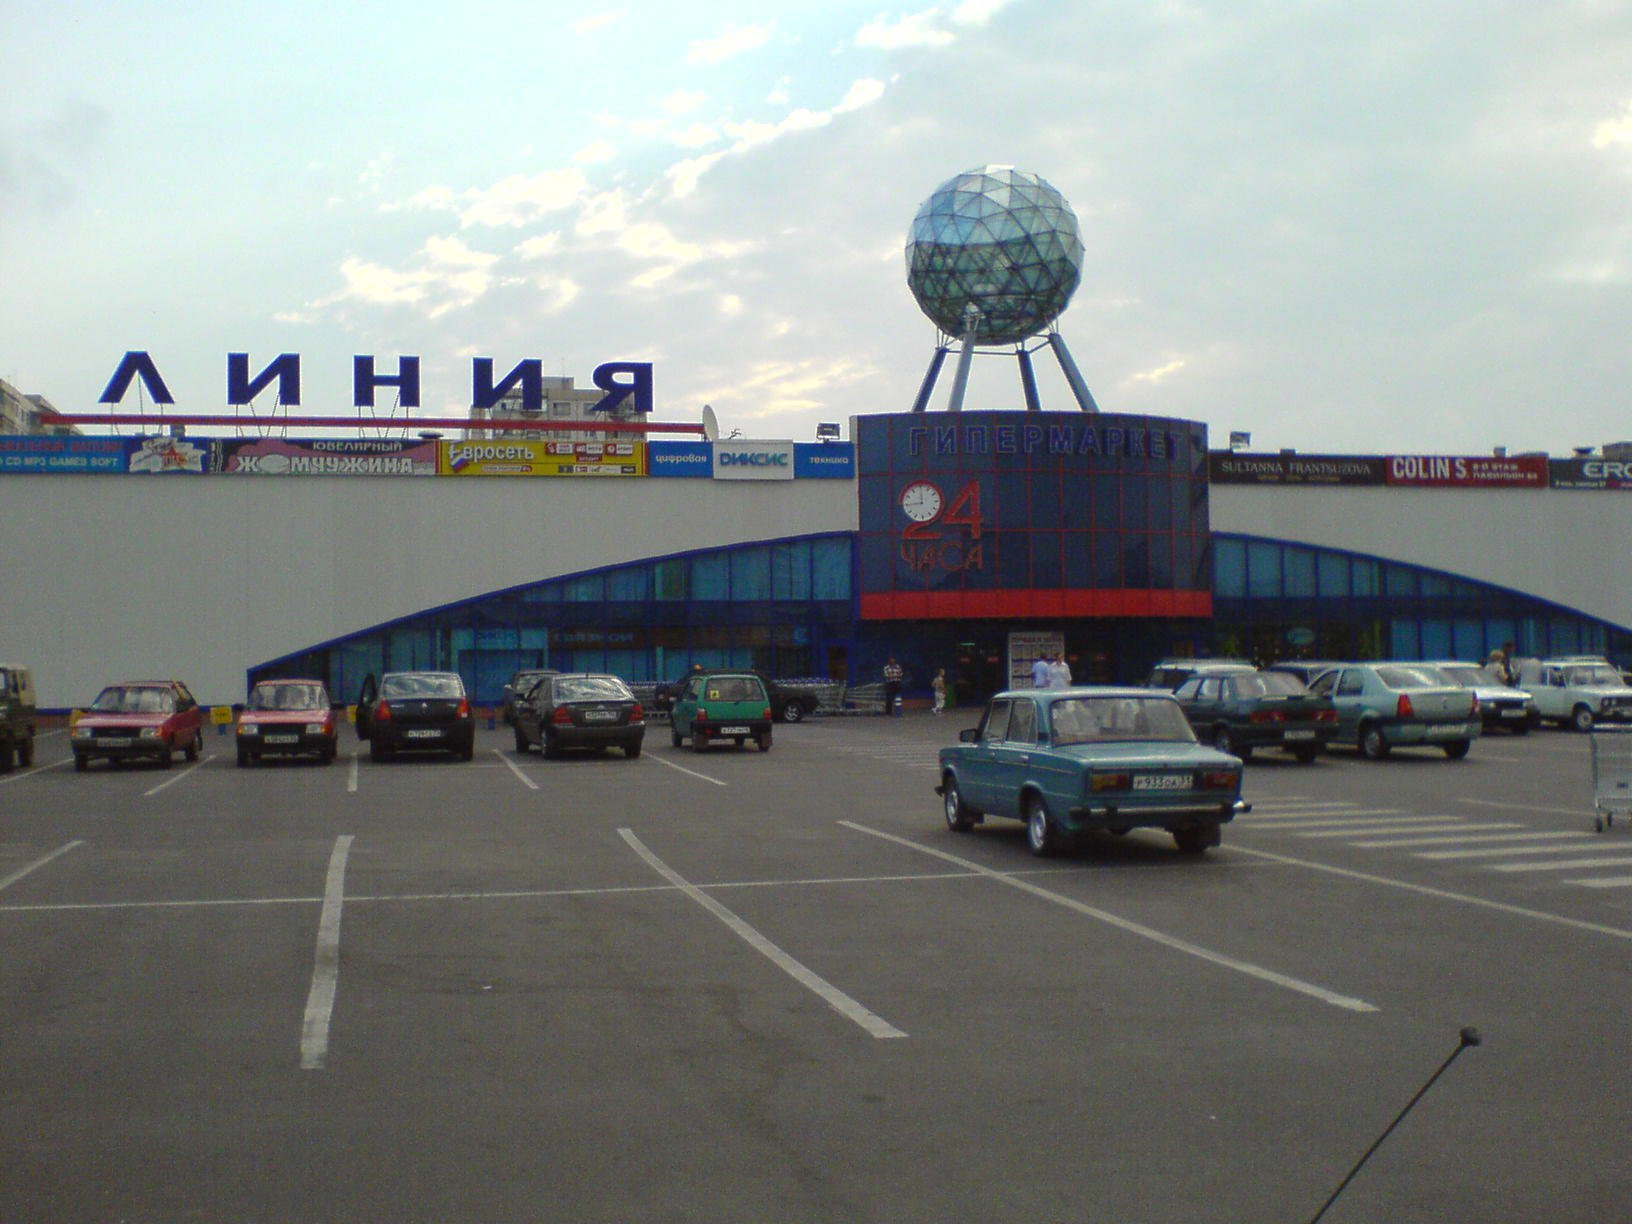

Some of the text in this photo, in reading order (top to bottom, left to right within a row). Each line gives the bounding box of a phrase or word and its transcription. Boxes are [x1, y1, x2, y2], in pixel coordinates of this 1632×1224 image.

[98, 350, 653, 412] ЛИНИЯ
[313, 442, 402, 451] ЮВЕЛИРНЫЙ
[910, 424, 1183, 460] ГИПЕРМАРКЕТ
[449, 444, 534, 462] Евросеть
[656, 455, 708, 465] цифровая
[1222, 462, 1283, 473] SULTANNA
[899, 479, 983, 540] 24
